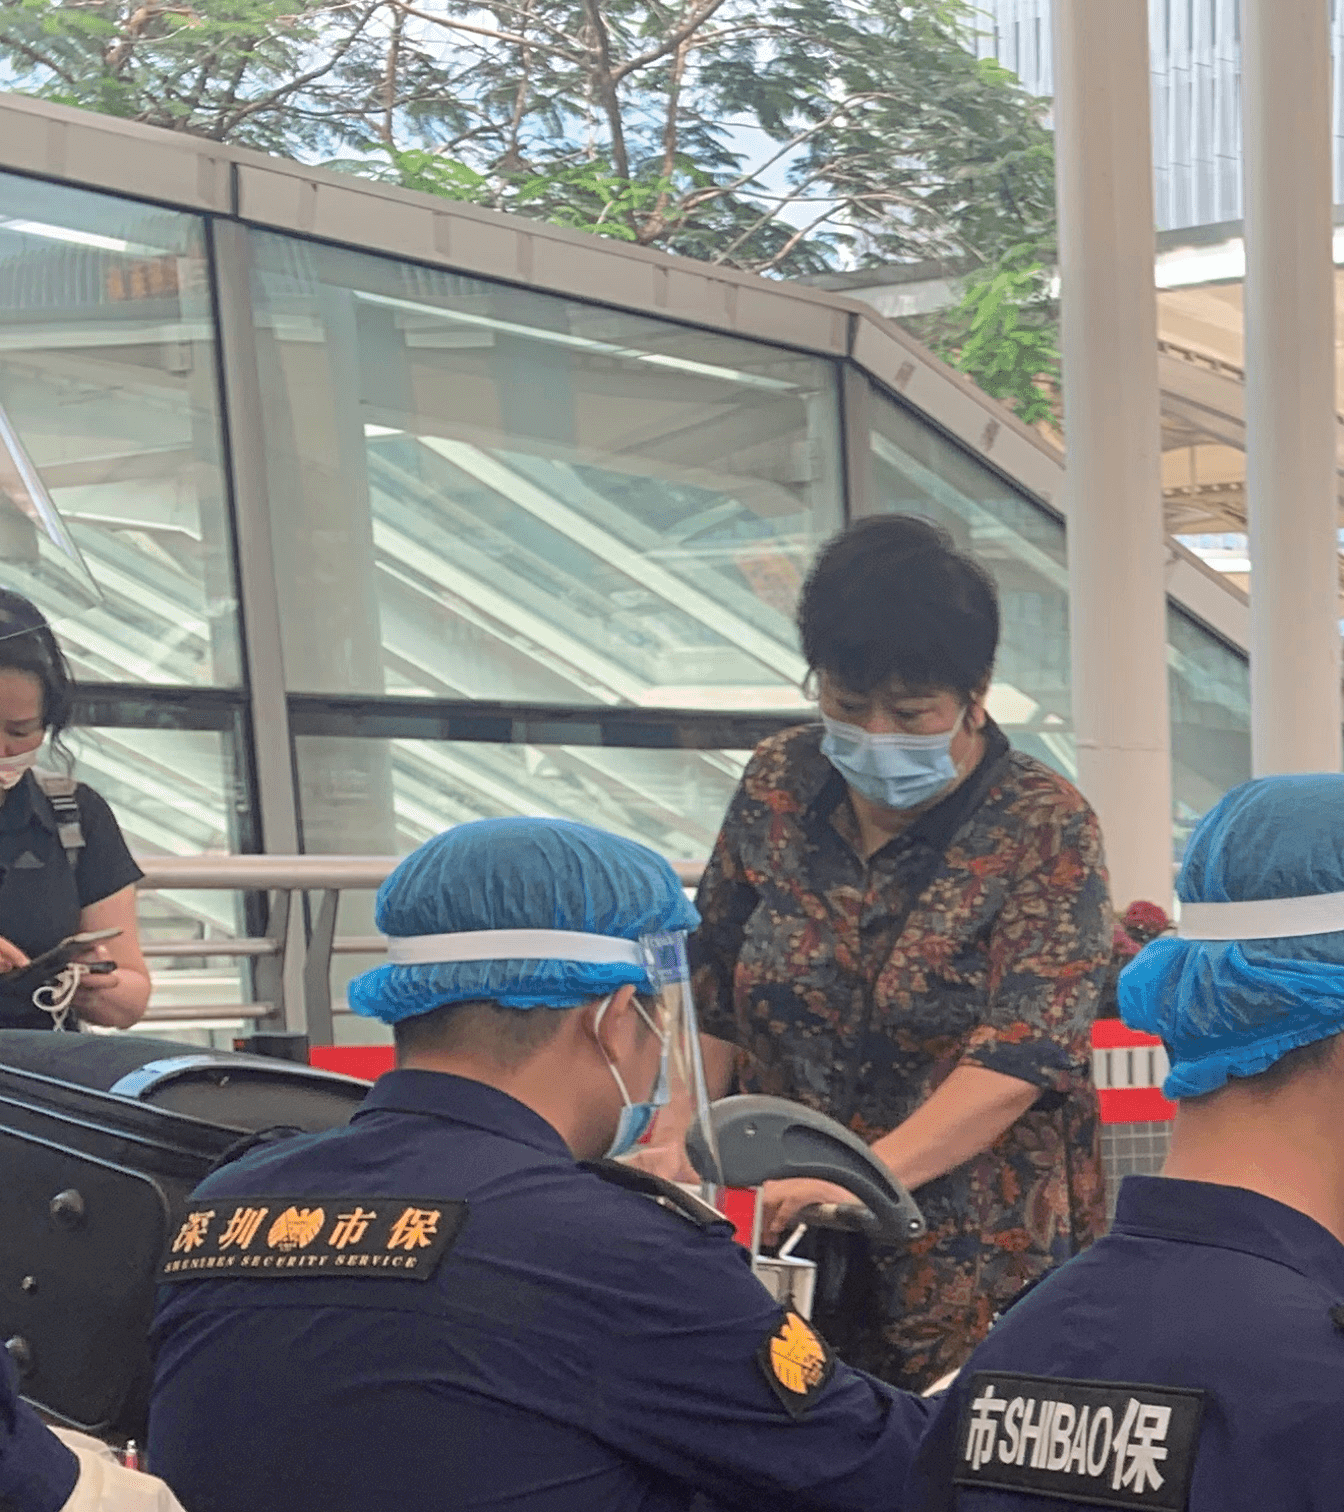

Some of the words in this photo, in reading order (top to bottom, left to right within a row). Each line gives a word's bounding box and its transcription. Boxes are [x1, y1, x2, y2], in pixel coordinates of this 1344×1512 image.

[163, 1256, 236, 1274] SHENZHEN
[241, 1255, 329, 1268] SECURITY
[334, 1255, 418, 1268] SERVICE
